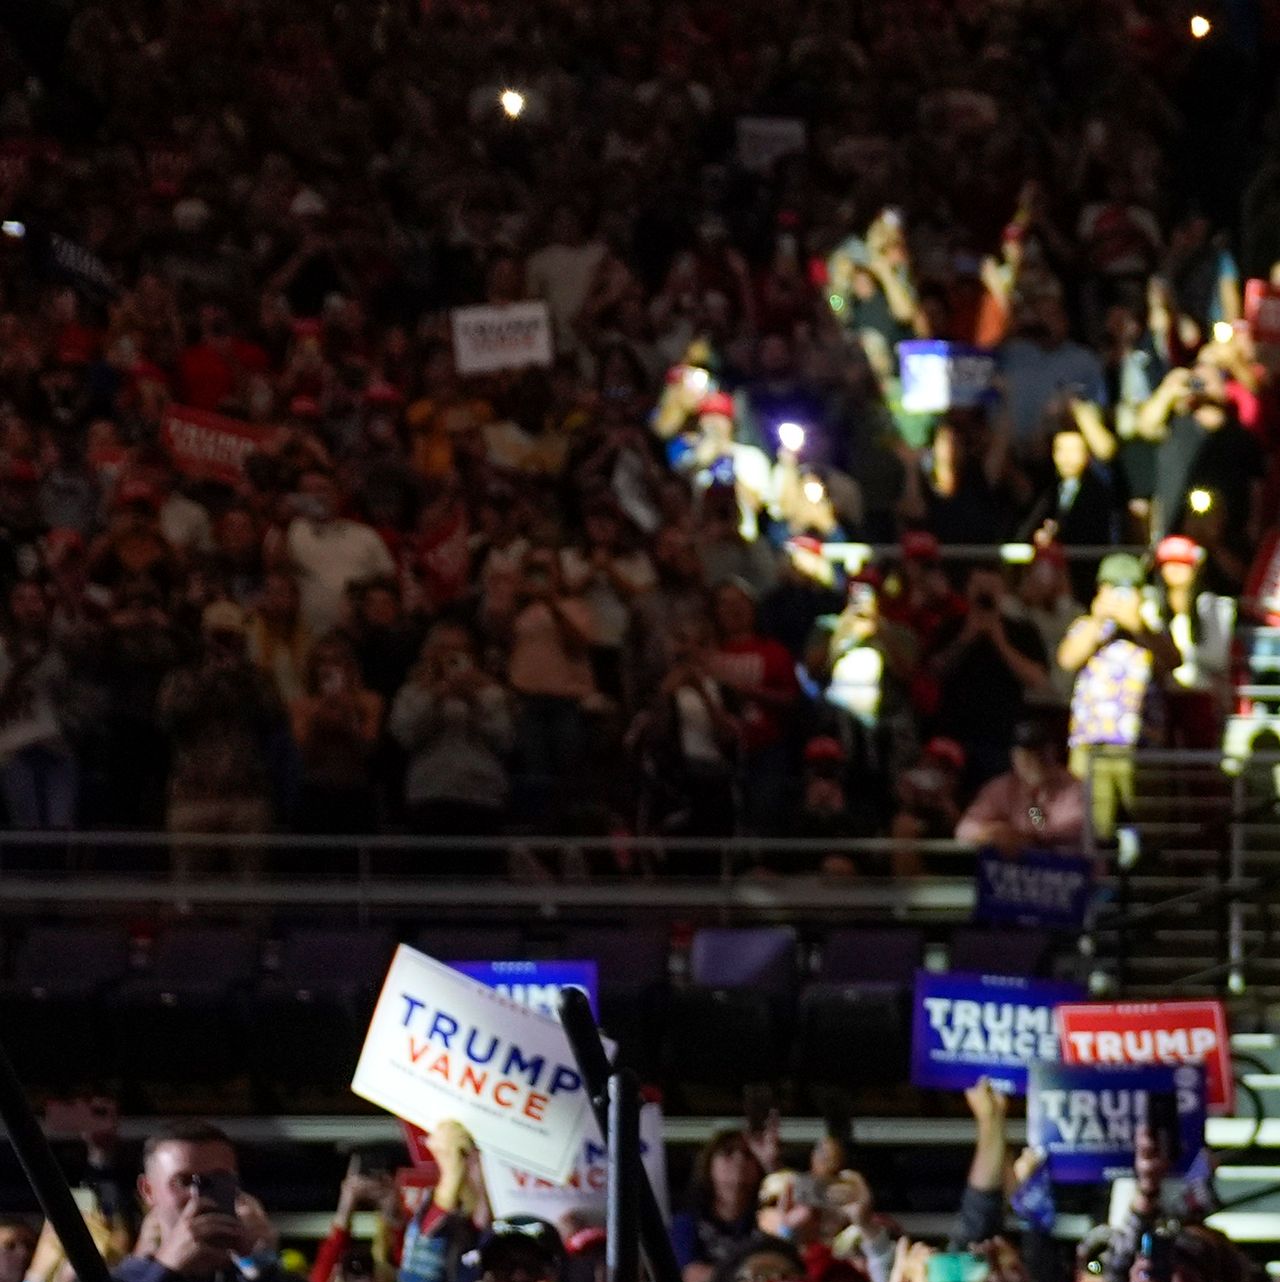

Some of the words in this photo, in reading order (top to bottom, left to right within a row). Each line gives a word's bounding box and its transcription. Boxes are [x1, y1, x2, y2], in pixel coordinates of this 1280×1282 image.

[923, 997, 1055, 1032] TRUM
[401, 993, 581, 1095] TRUMP
[940, 1023, 1058, 1056] VANCE
[1069, 1027, 1217, 1064] TRUMP
[407, 1037, 549, 1121] VANCE
